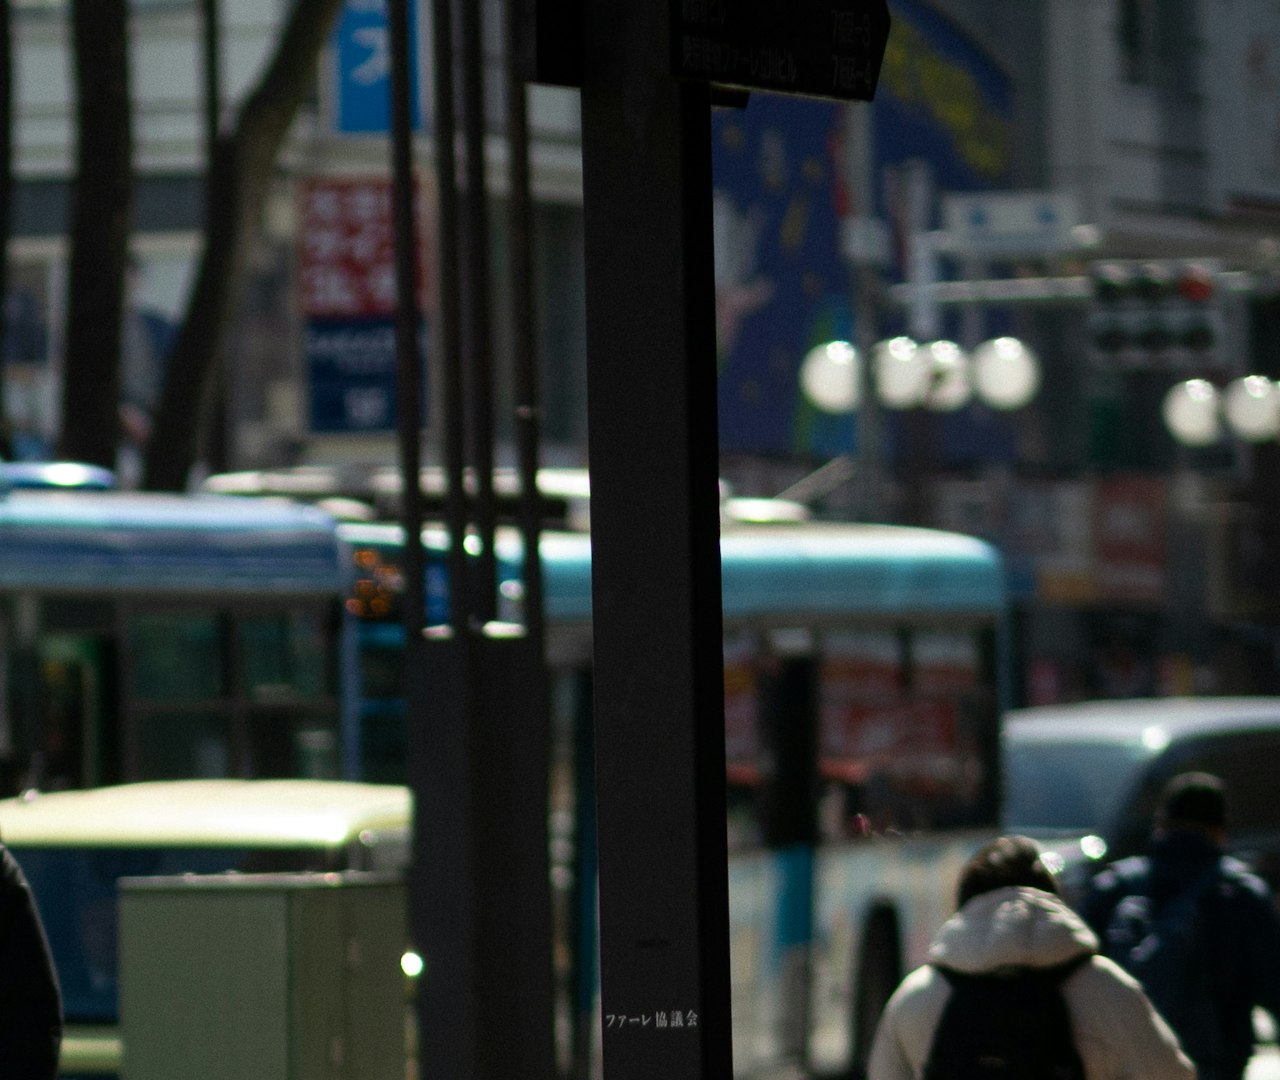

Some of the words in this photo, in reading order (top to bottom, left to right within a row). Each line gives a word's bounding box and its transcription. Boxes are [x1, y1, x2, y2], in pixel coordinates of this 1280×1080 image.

[604, 1009, 700, 1029] ファーレ協議会
